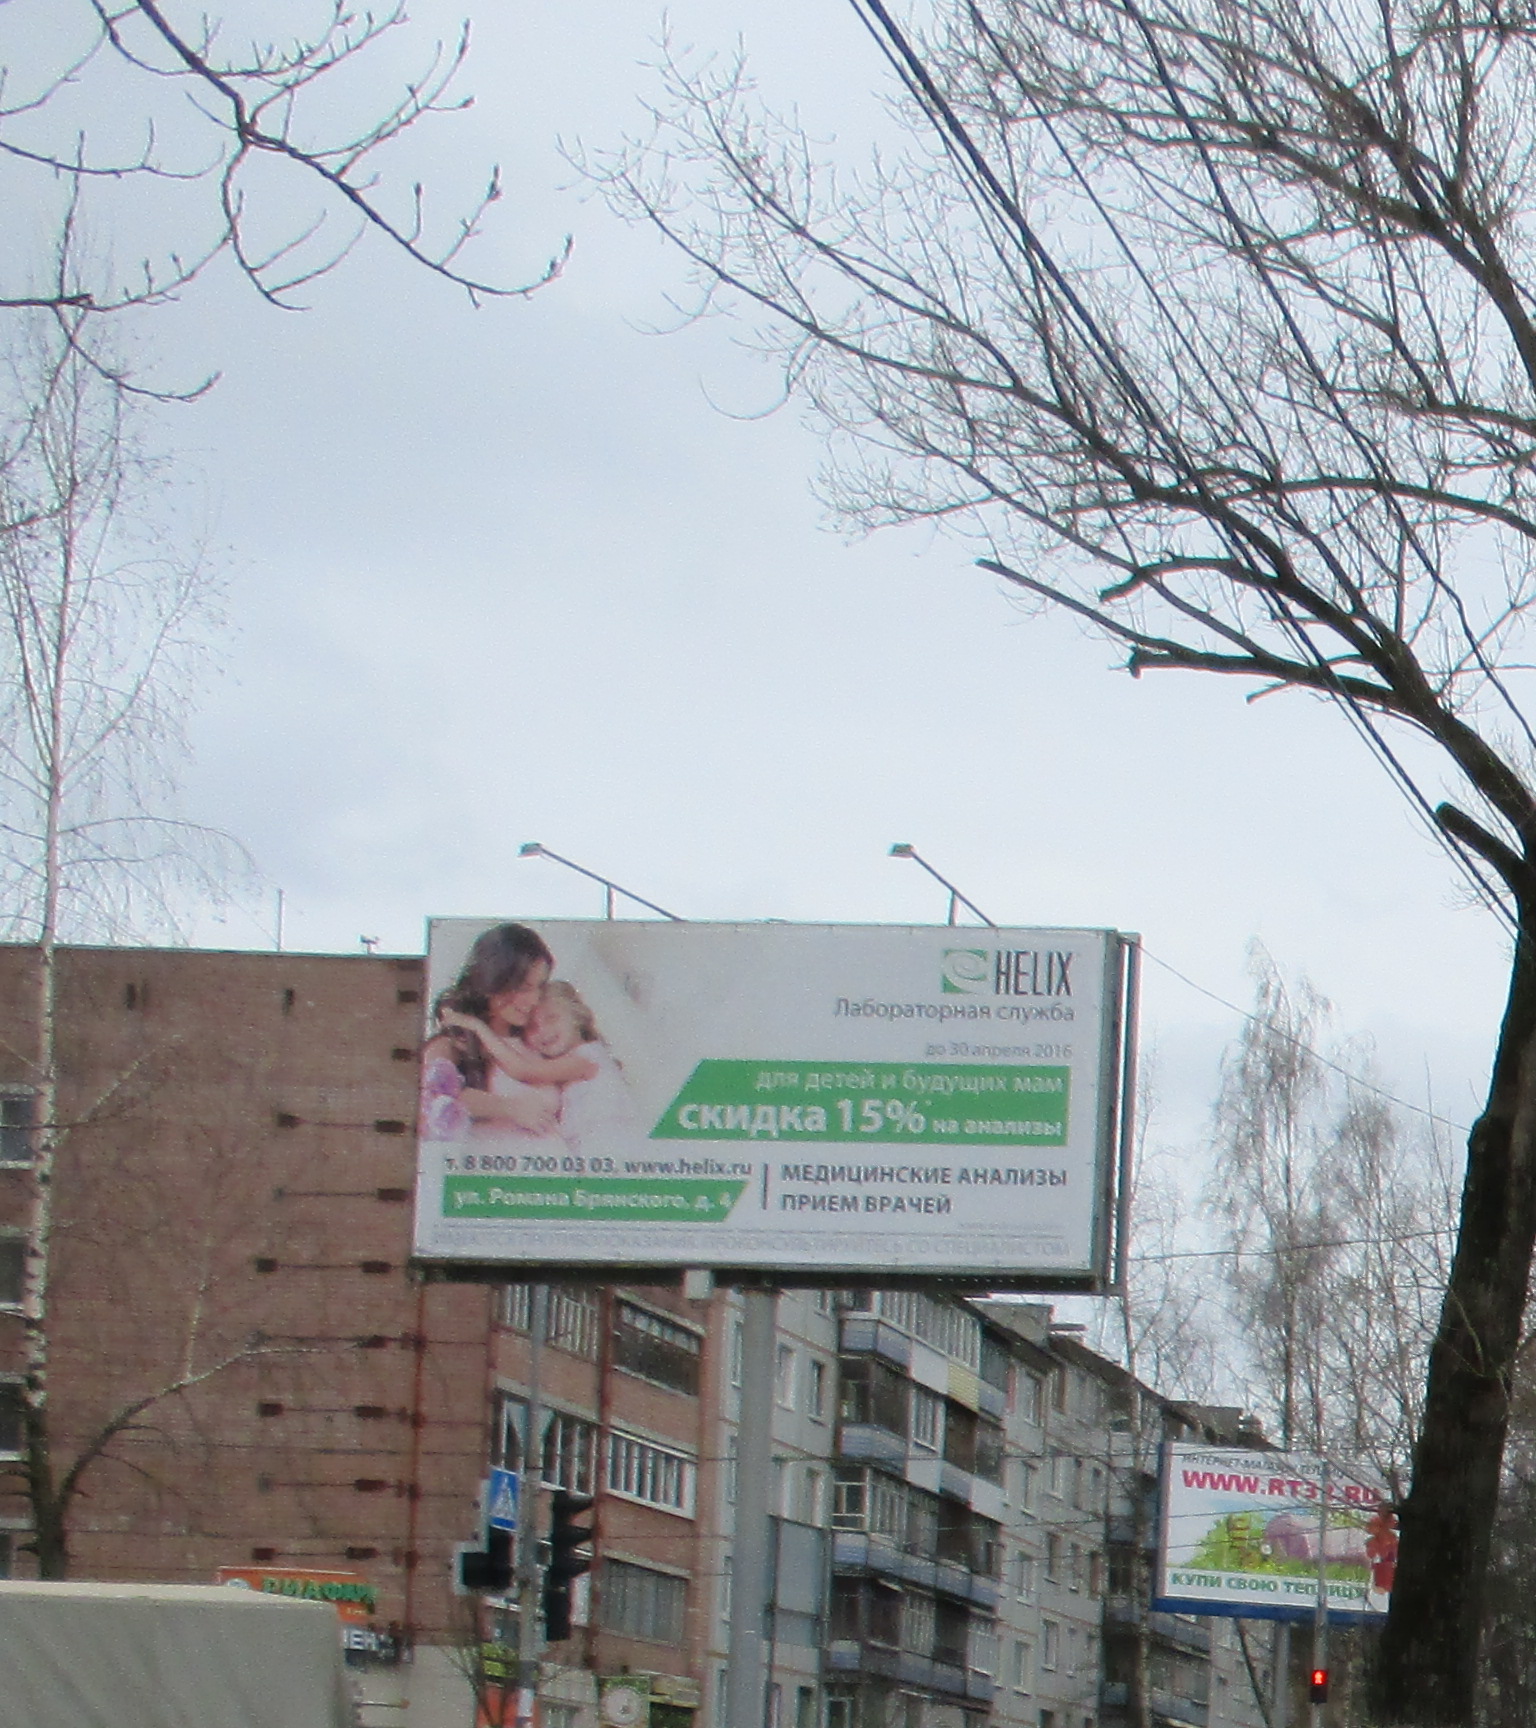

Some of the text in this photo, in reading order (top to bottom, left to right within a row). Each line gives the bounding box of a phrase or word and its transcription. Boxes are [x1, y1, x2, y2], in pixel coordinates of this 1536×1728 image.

[995, 950, 1073, 996] HELIX
[834, 998, 1074, 1024] Лабораторная служба
[1035, 1043, 1073, 1059] 2016
[755, 1069, 1064, 1094] для детей и будущих мам
[678, 1103, 825, 1138] скидка
[932, 1119, 959, 1134] на
[965, 1119, 1062, 1136] анализы
[464, 1155, 476, 1171] 8
[480, 1155, 517, 1171] 800
[523, 1156, 558, 1172] 700
[562, 1156, 586, 1173] 03
[624, 1158, 753, 1176] www.helix.ru
[782, 1163, 1067, 1186] МЕДИЦИНСКИЕ АНАЛИЗЫ
[782, 1193, 951, 1214] ПРИЕМ ВРАЧЕЙ
[1172, 1572, 1369, 1599] КУПИ СВОЮ ТЕПИЦУ
